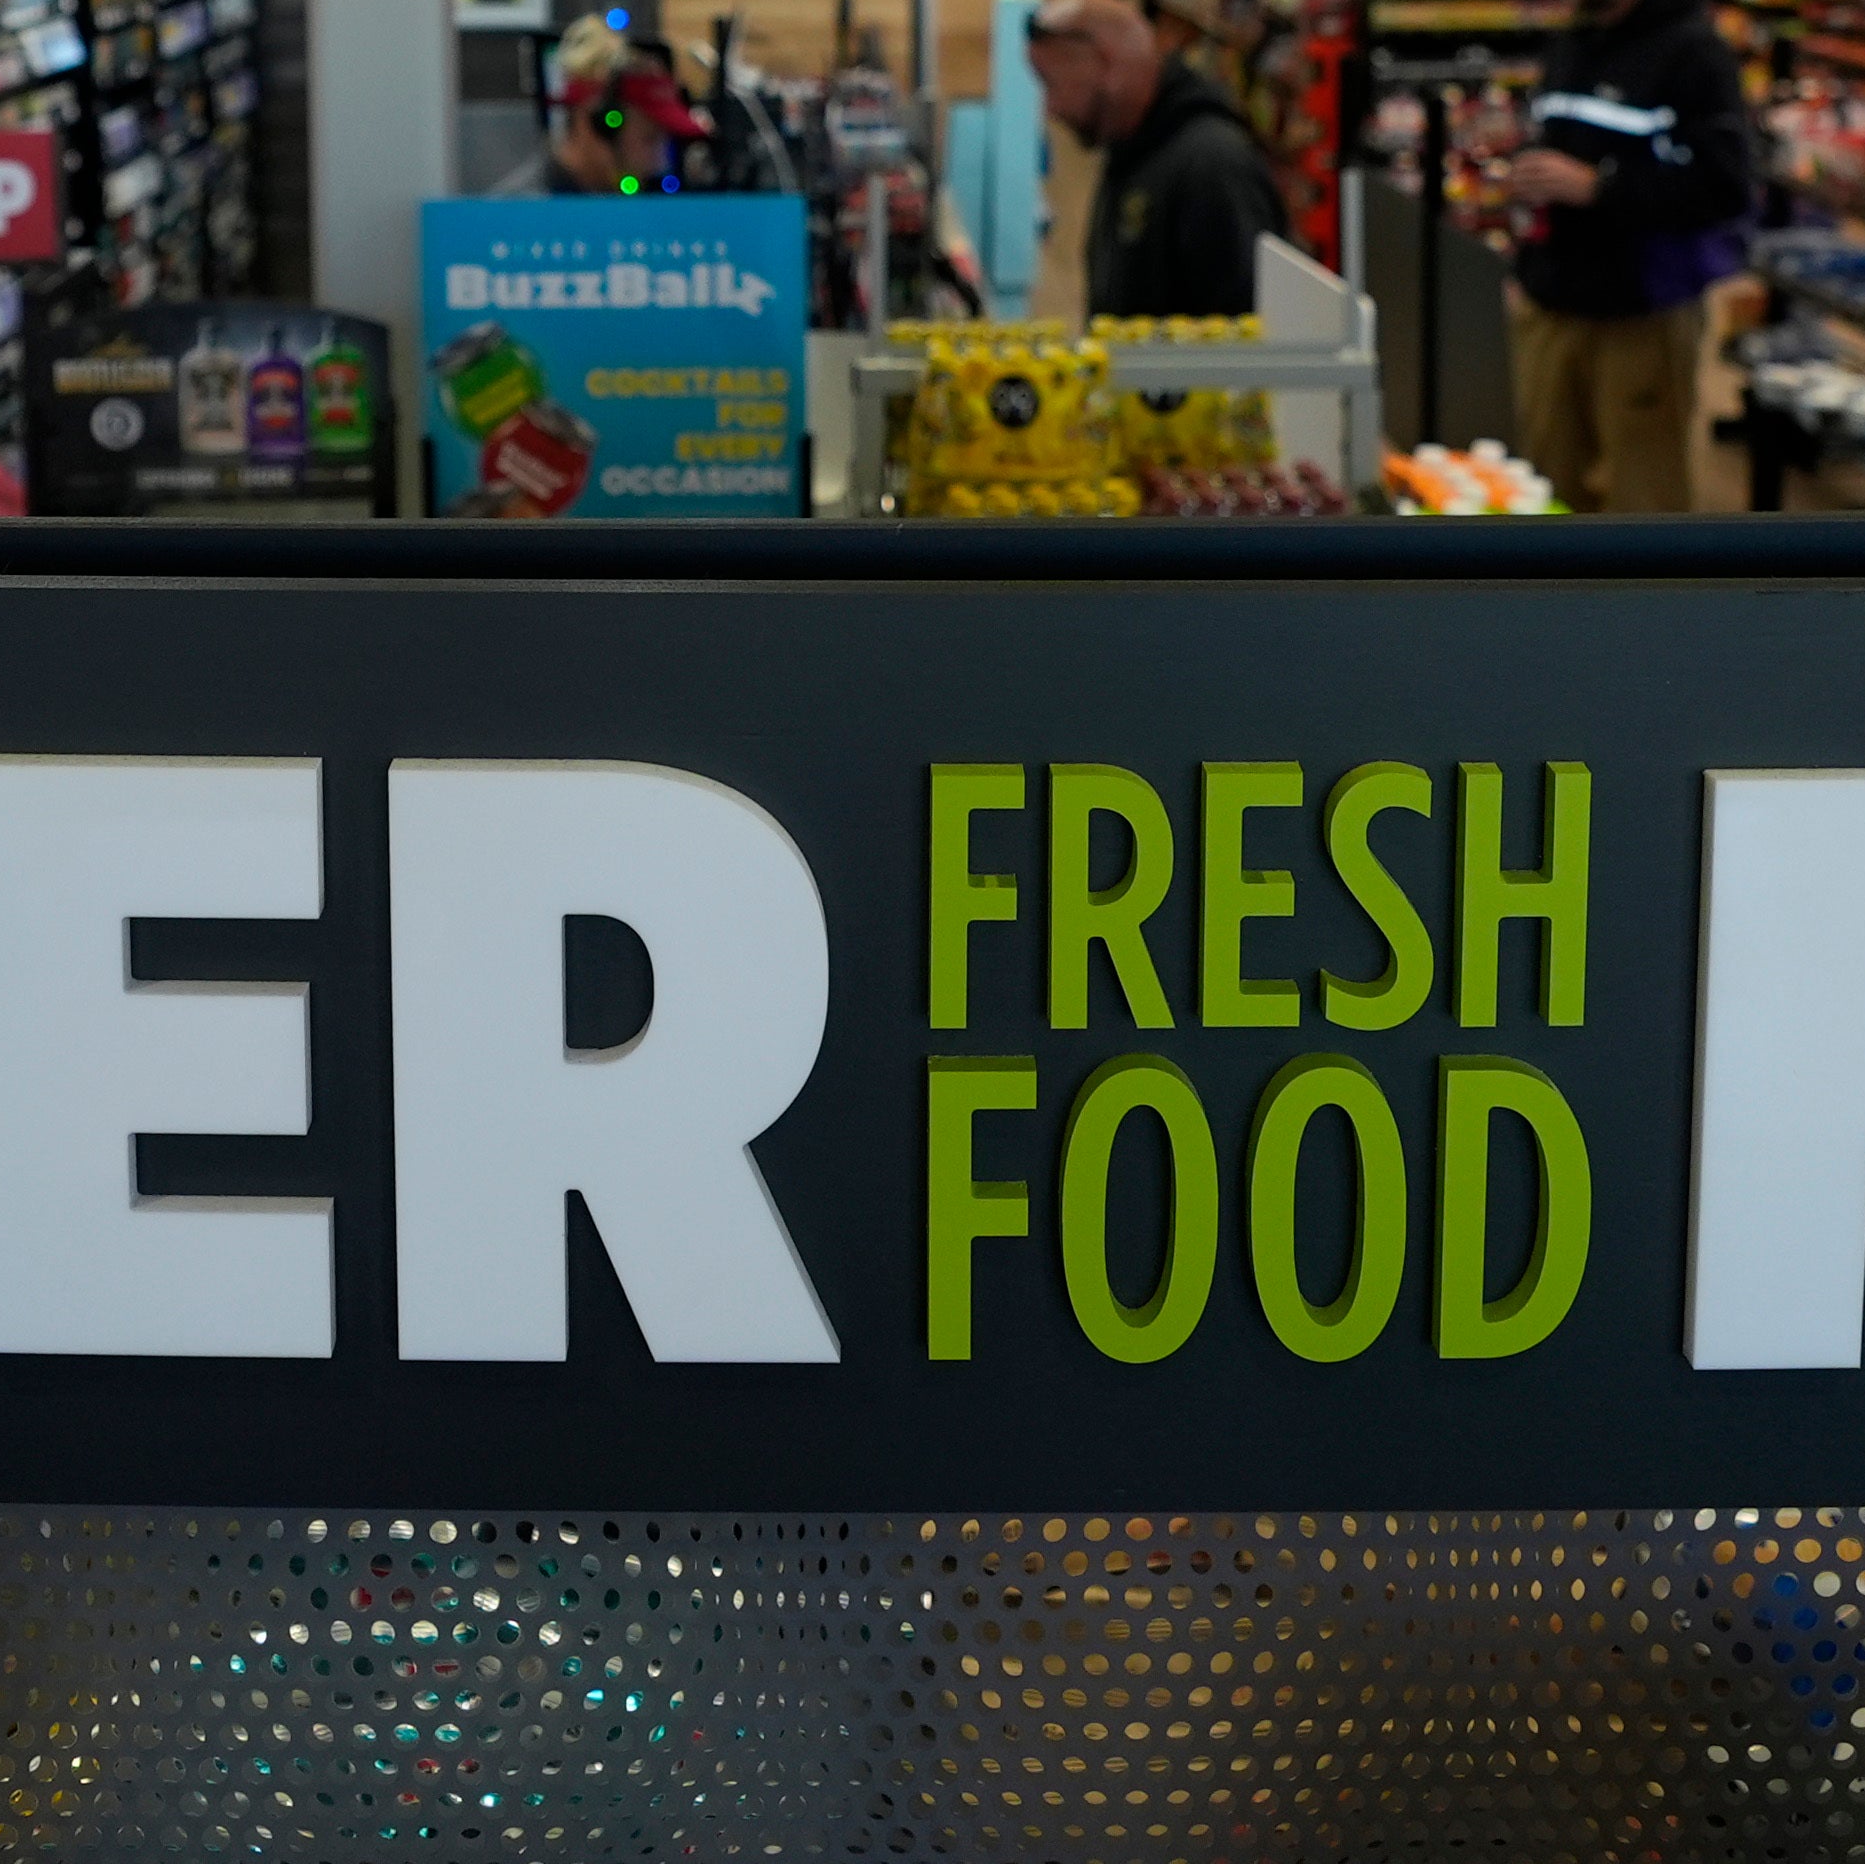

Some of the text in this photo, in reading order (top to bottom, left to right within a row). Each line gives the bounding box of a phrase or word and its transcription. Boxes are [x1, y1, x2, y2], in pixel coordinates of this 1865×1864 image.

[585, 367, 789, 397] COCKTAILS
[600, 466, 791, 497] OCCASION
[923, 759, 1593, 1032] FRESH
[923, 1054, 1594, 1364] FOOD
